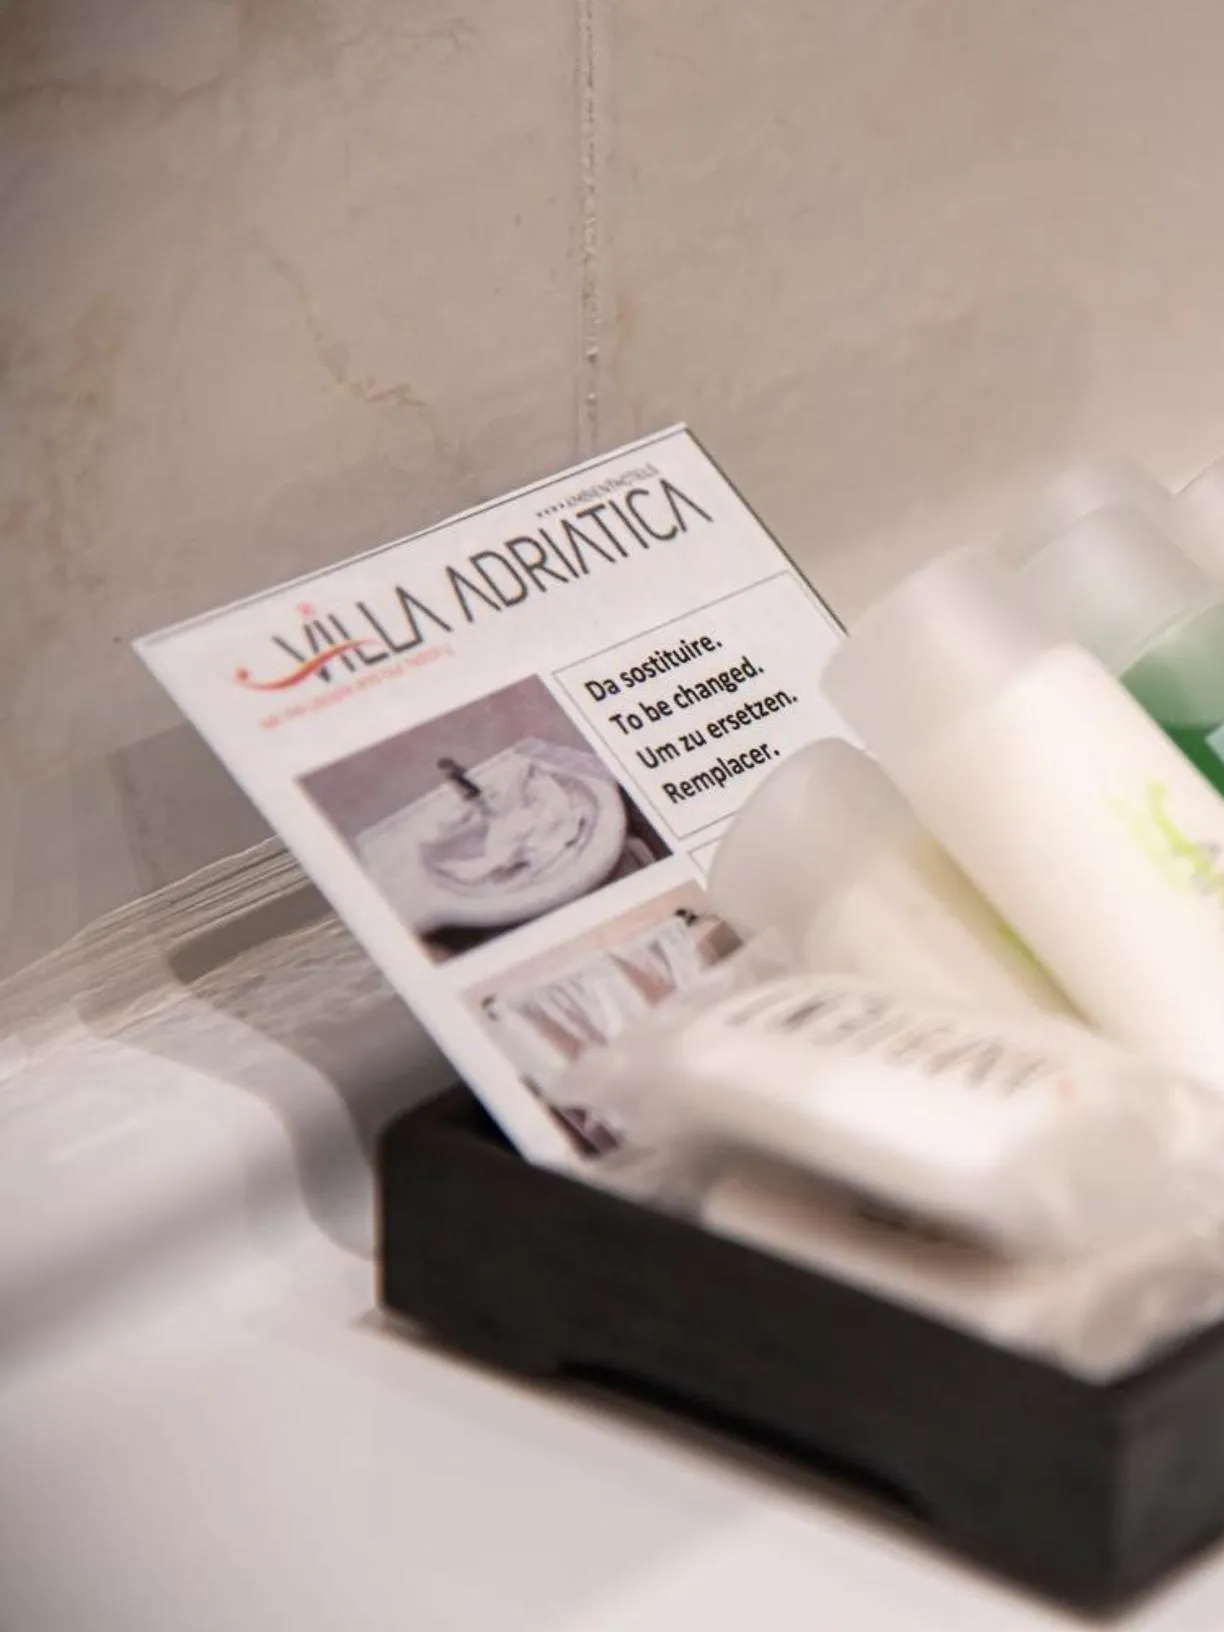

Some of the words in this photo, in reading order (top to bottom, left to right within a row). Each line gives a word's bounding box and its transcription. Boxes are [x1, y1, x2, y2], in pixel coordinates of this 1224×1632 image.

[272, 583, 454, 683] VILLA
[444, 477, 713, 624] ADRIATICA
[584, 679, 621, 703] Da
[619, 634, 724, 689] sostituire.
[609, 713, 644, 736] To
[638, 698, 674, 723] be
[672, 655, 766, 710] changed.
[635, 742, 682, 771] Um
[677, 728, 708, 753] zu
[706, 689, 800, 740] ersetzen.
[661, 743, 782, 805] Remplacer.
